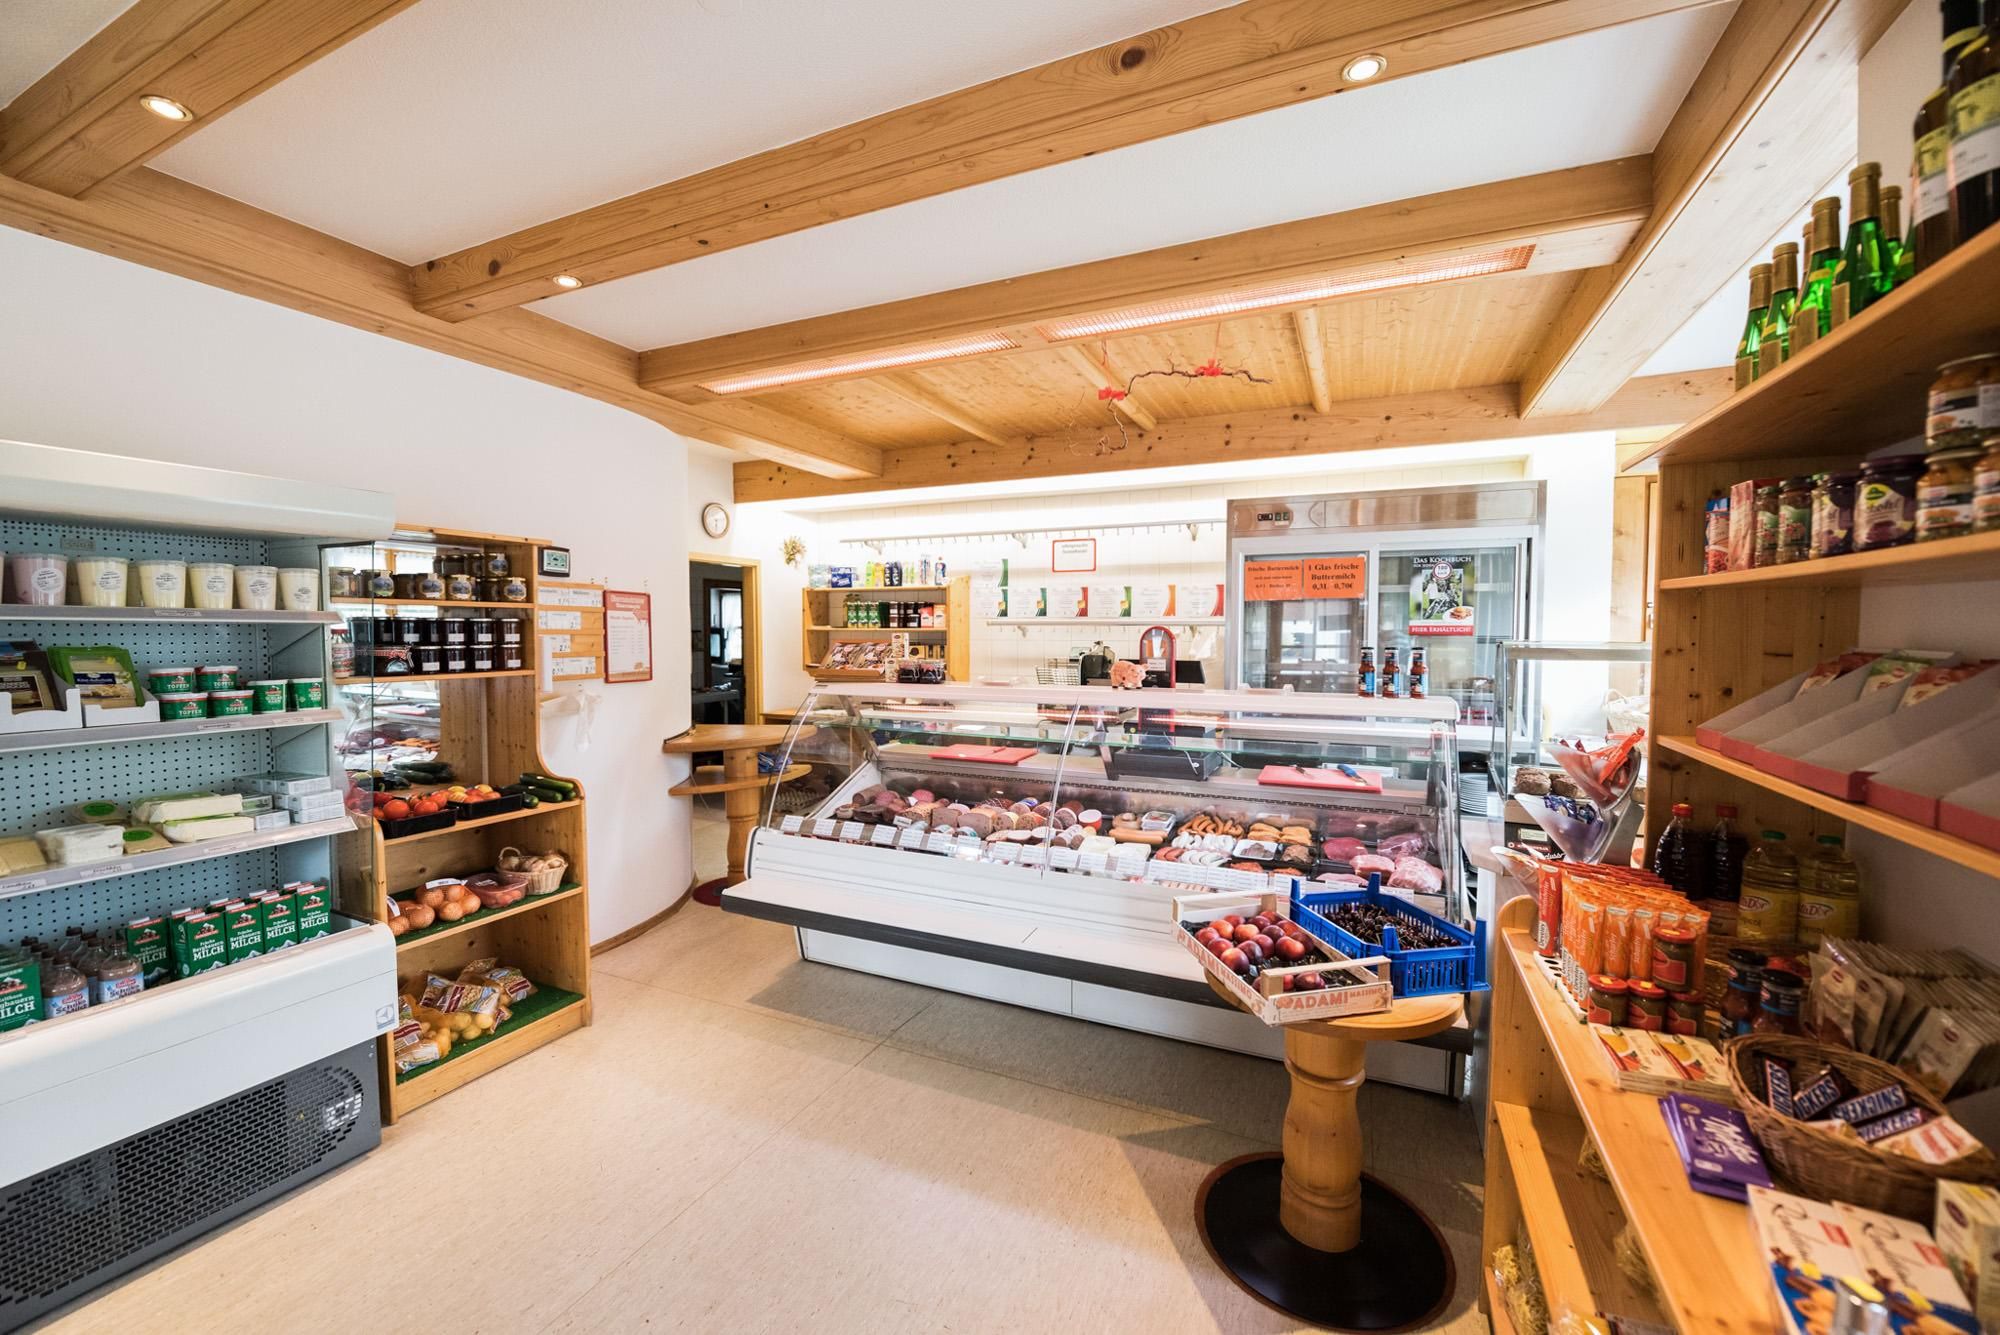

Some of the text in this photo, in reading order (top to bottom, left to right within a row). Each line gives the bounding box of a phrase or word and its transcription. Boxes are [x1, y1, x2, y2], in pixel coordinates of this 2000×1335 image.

[1333, 563, 1360, 571] frische
[1311, 573, 1357, 581] Buttermilch
[300, 916, 329, 930] MILCH
[266, 924, 296, 940] MILCH
[230, 934, 262, 950] MILCH
[192, 944, 225, 961] MILCH
[1293, 986, 1384, 1010] ADAMI MASSIMO
